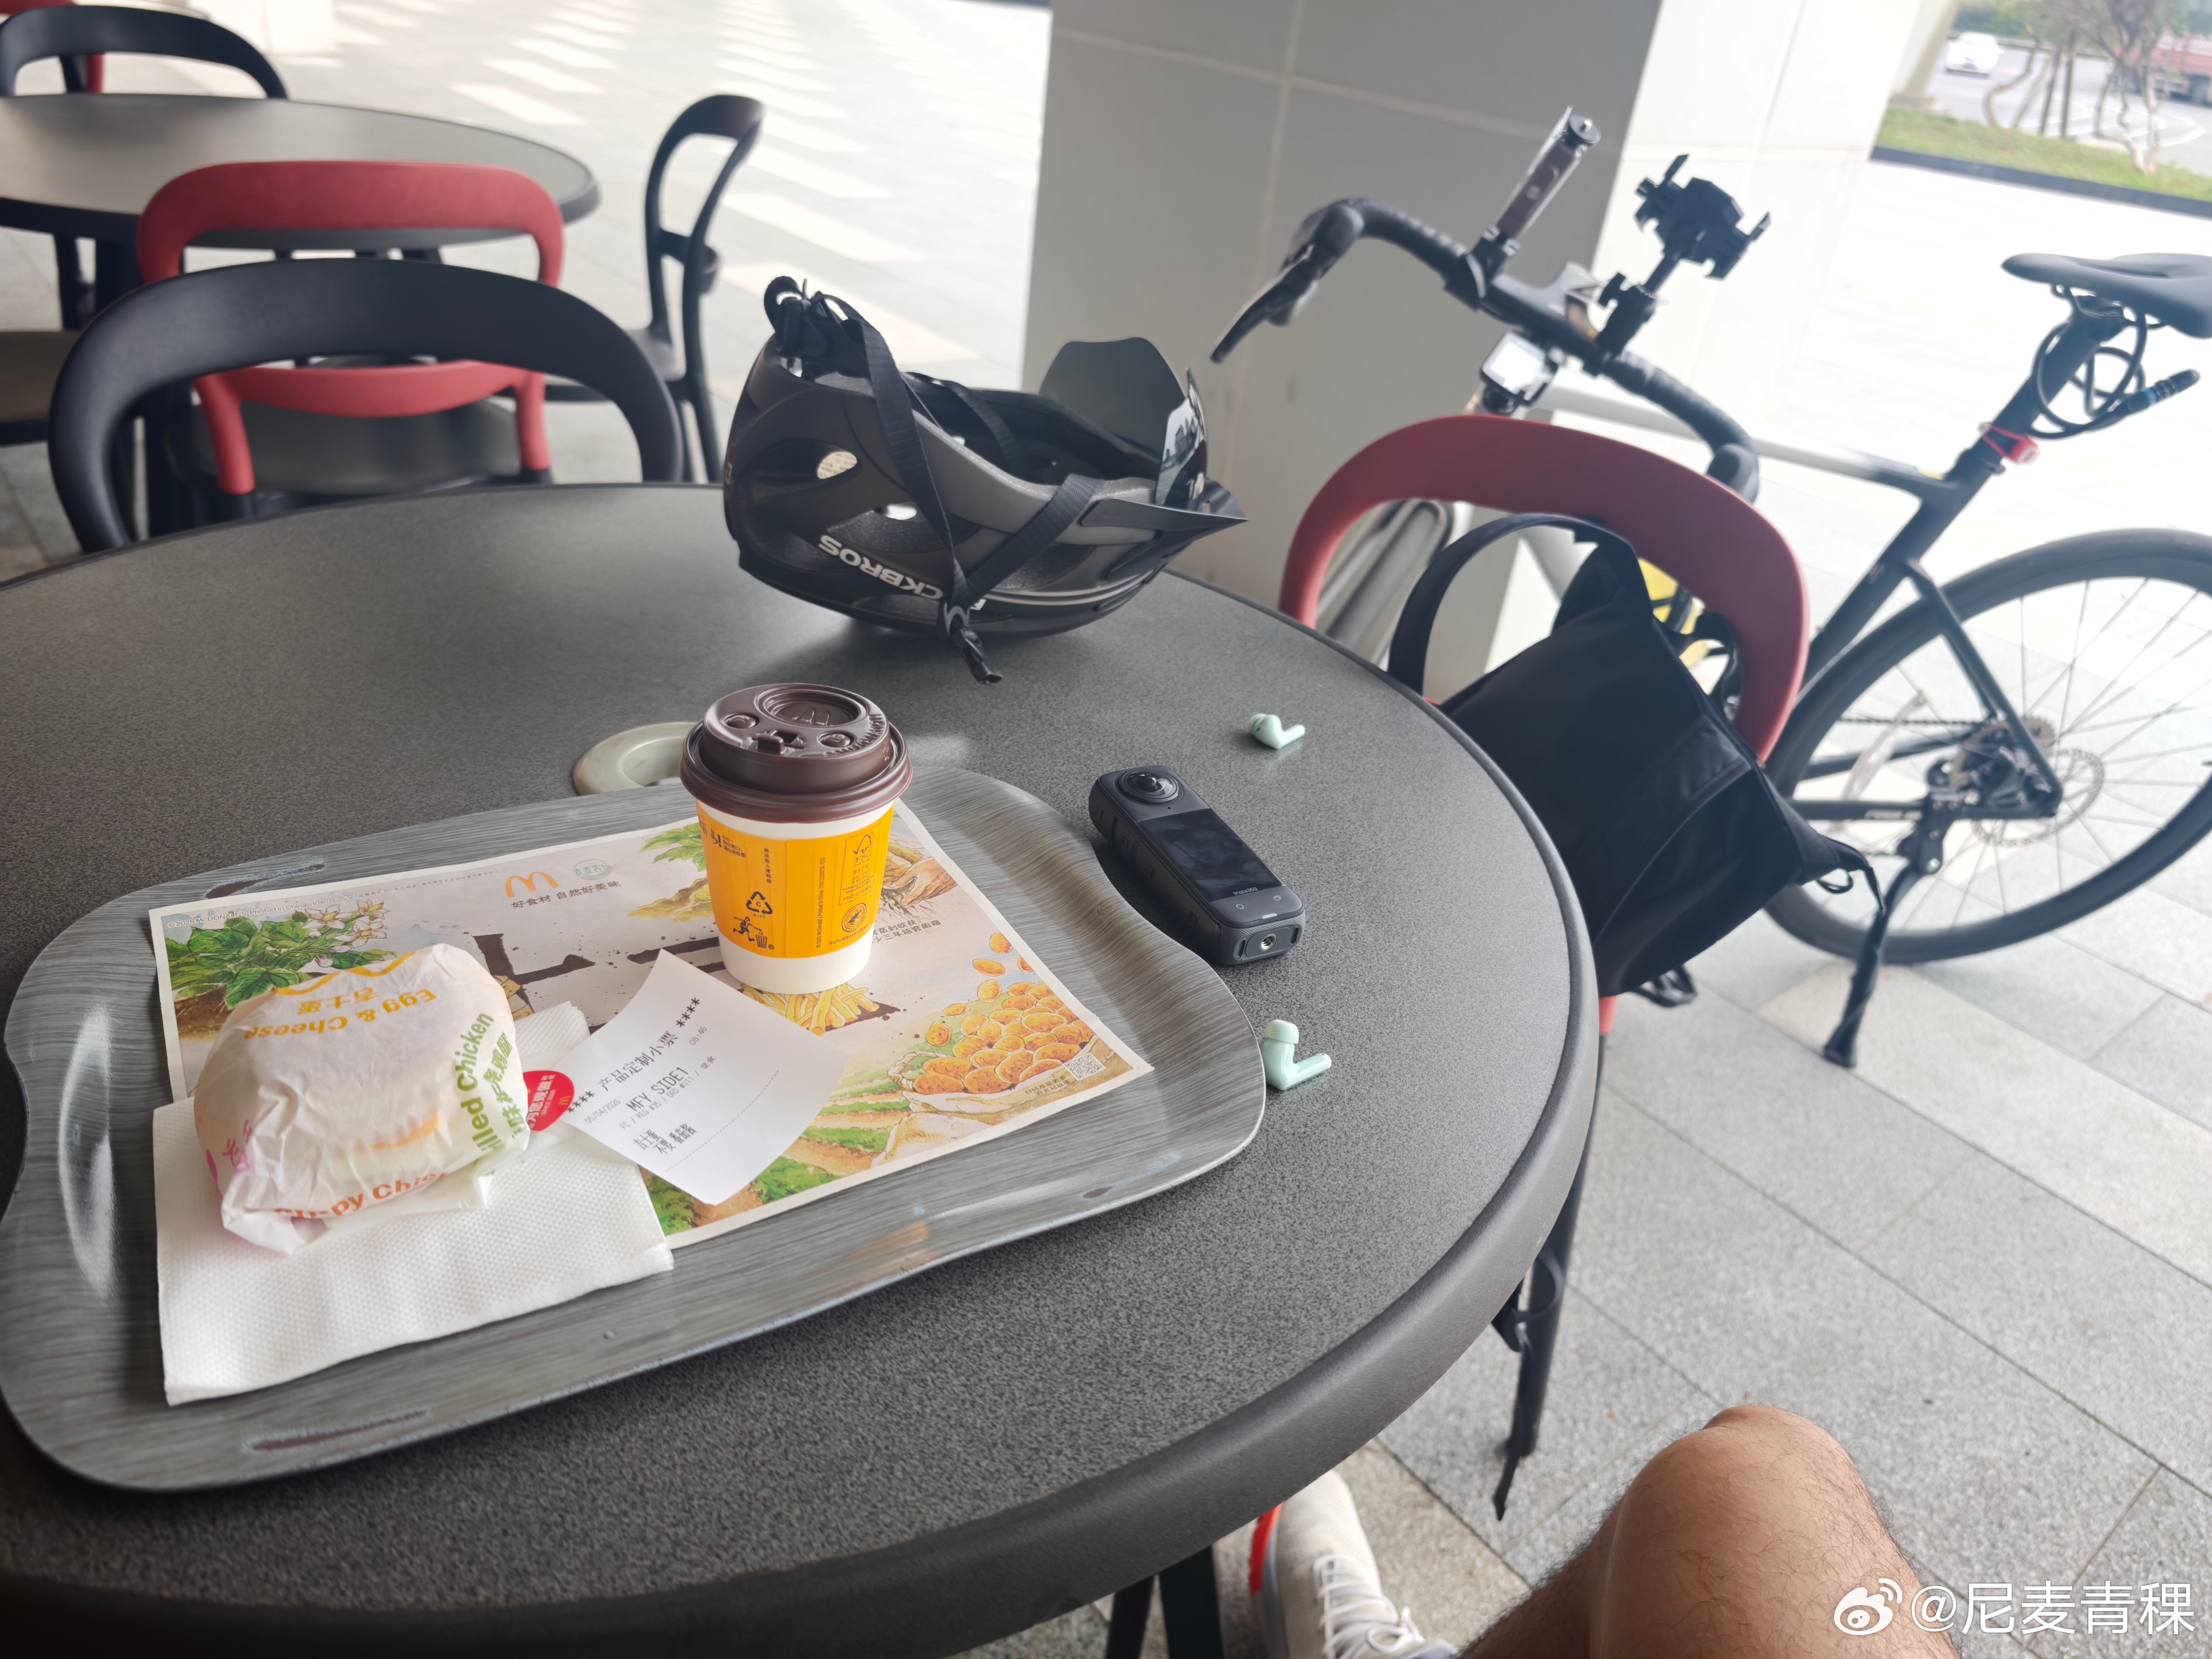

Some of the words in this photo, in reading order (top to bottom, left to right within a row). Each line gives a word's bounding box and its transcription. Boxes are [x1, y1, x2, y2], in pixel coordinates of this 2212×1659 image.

[511, 894, 551, 909] 好食材
[557, 880, 622, 900] 自然好美味
[1232, 887, 1258, 895] Insta360
[196, 910, 247, 924] McDONALD'S
[249, 907, 276, 916] Printed
[309, 898, 335, 907] (10407)
[872, 920, 941, 943] 少三年培育周期
[297, 987, 380, 1015] 吉士蛋
[382, 988, 437, 1014] Egg
[245, 1016, 348, 1040] Cheese
[355, 1009, 376, 1023] &
[689, 1026, 707, 1046] 08:46
[455, 1013, 495, 1092] Chicken
[597, 1030, 678, 1092] 产品定制小票
[619, 1121, 631, 1130] FC
[635, 1108, 650, 1120] REG
[700, 1055, 716, 1070] 堂食
[625, 1092, 652, 1112] MFY
[650, 1067, 689, 1095] SIDE1
[632, 1129, 662, 1151] 吉士蛋
[652, 1137, 677, 1155] 不要
[669, 1123, 698, 1144] 番茄酱
